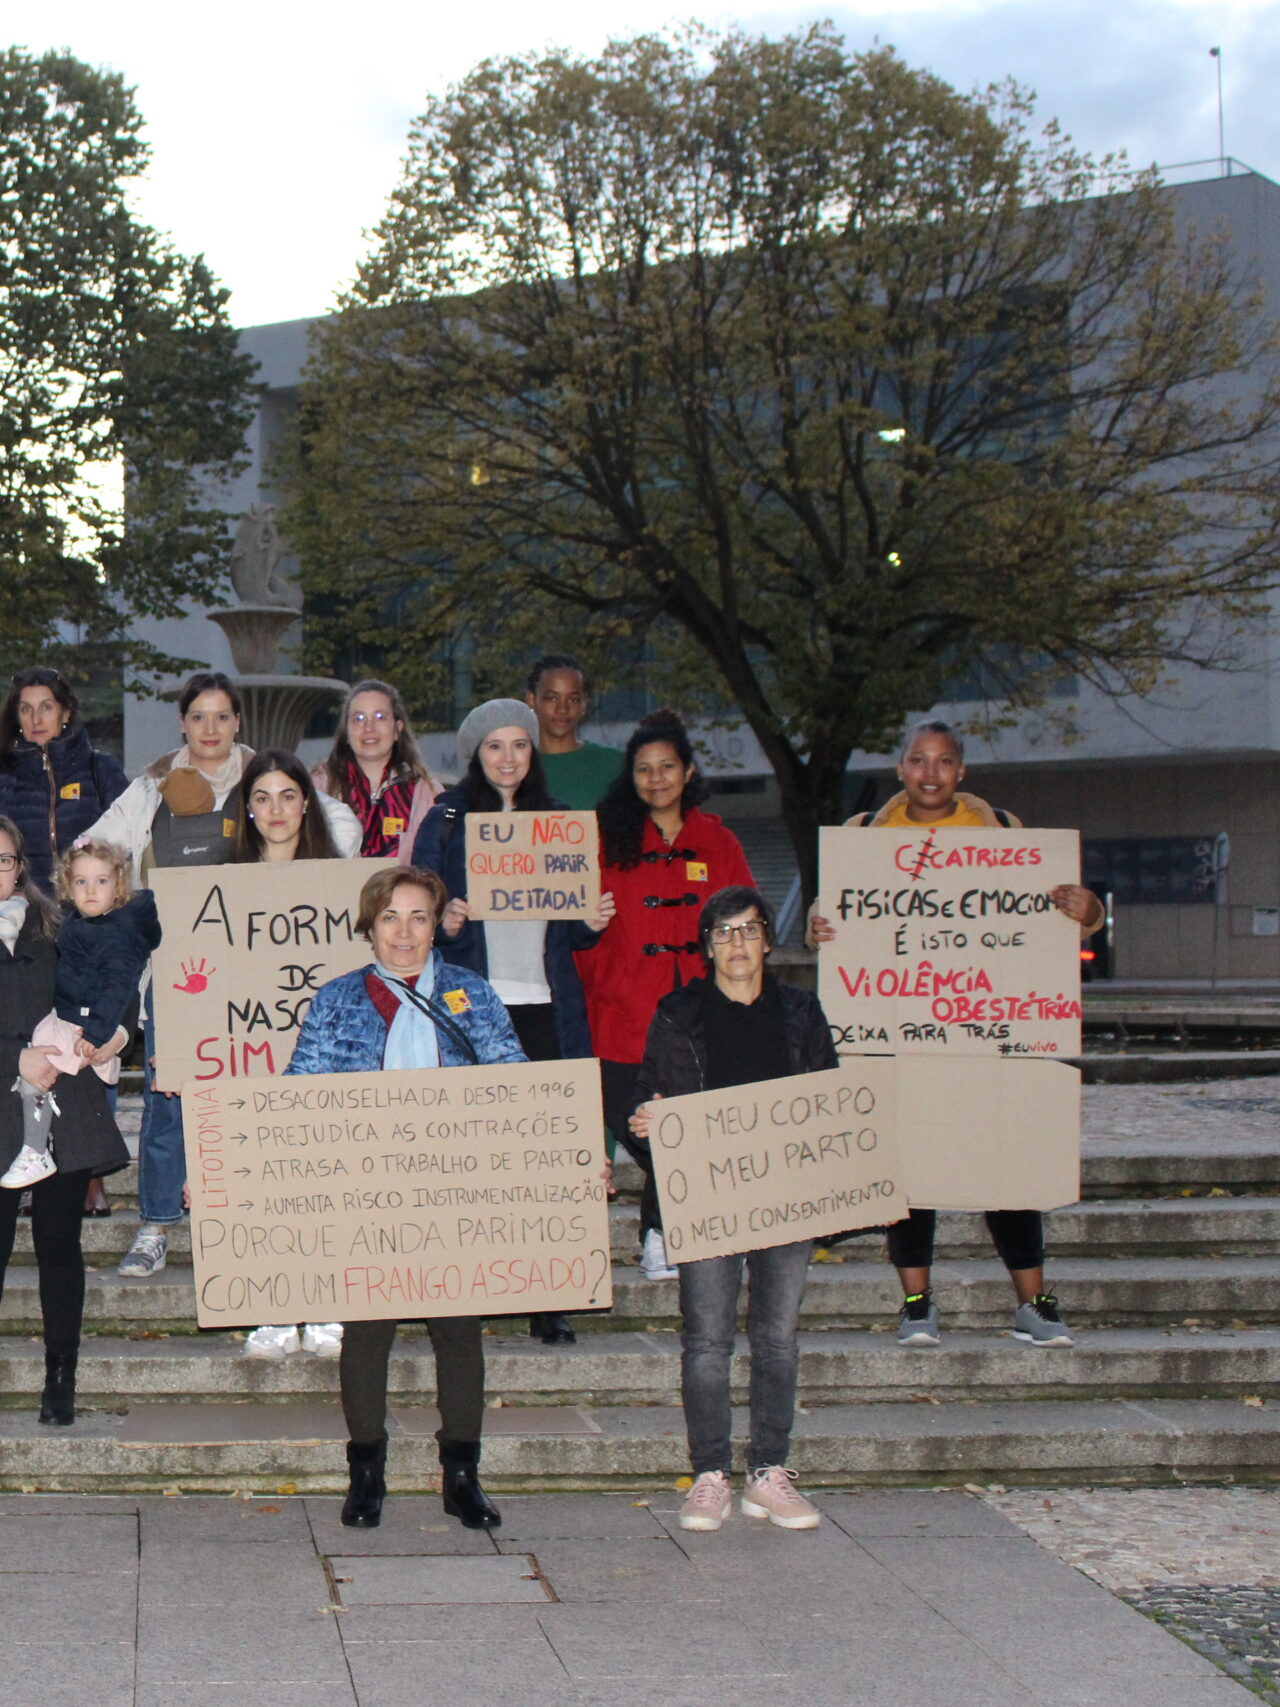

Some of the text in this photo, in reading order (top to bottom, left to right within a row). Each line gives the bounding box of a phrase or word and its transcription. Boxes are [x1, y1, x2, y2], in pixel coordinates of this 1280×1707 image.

[479, 815, 585, 847] EU NÃO
[469, 853, 536, 876] QUERO
[192, 884, 353, 950] A FORM
[960, 889, 1054, 918] EMOCION
[895, 923, 908, 956] É
[981, 932, 1026, 950] QUE
[277, 963, 326, 991] DE
[227, 997, 312, 1034] NASC
[899, 1022, 947, 1044] PARA
[960, 1022, 1010, 1040] TRÁS
[252, 1081, 576, 1113] DESACONSELHADA DESDE 1996
[391, 1123, 417, 1142] AS
[426, 1111, 579, 1139] CONTRAÇÕES
[659, 1086, 875, 1148] O MEU CORPO
[261, 1148, 592, 1182] ATRASA O TRABALHO DE PARTO
[667, 1127, 877, 1204] O MEU PARTO
[263, 1193, 337, 1217] AUMENTA
[198, 1218, 337, 1262] PORQUE
[669, 1226, 682, 1250] O
[691, 1213, 738, 1244] MEU
[200, 1249, 608, 1312] COMO UM FRANGO ASSADO?
